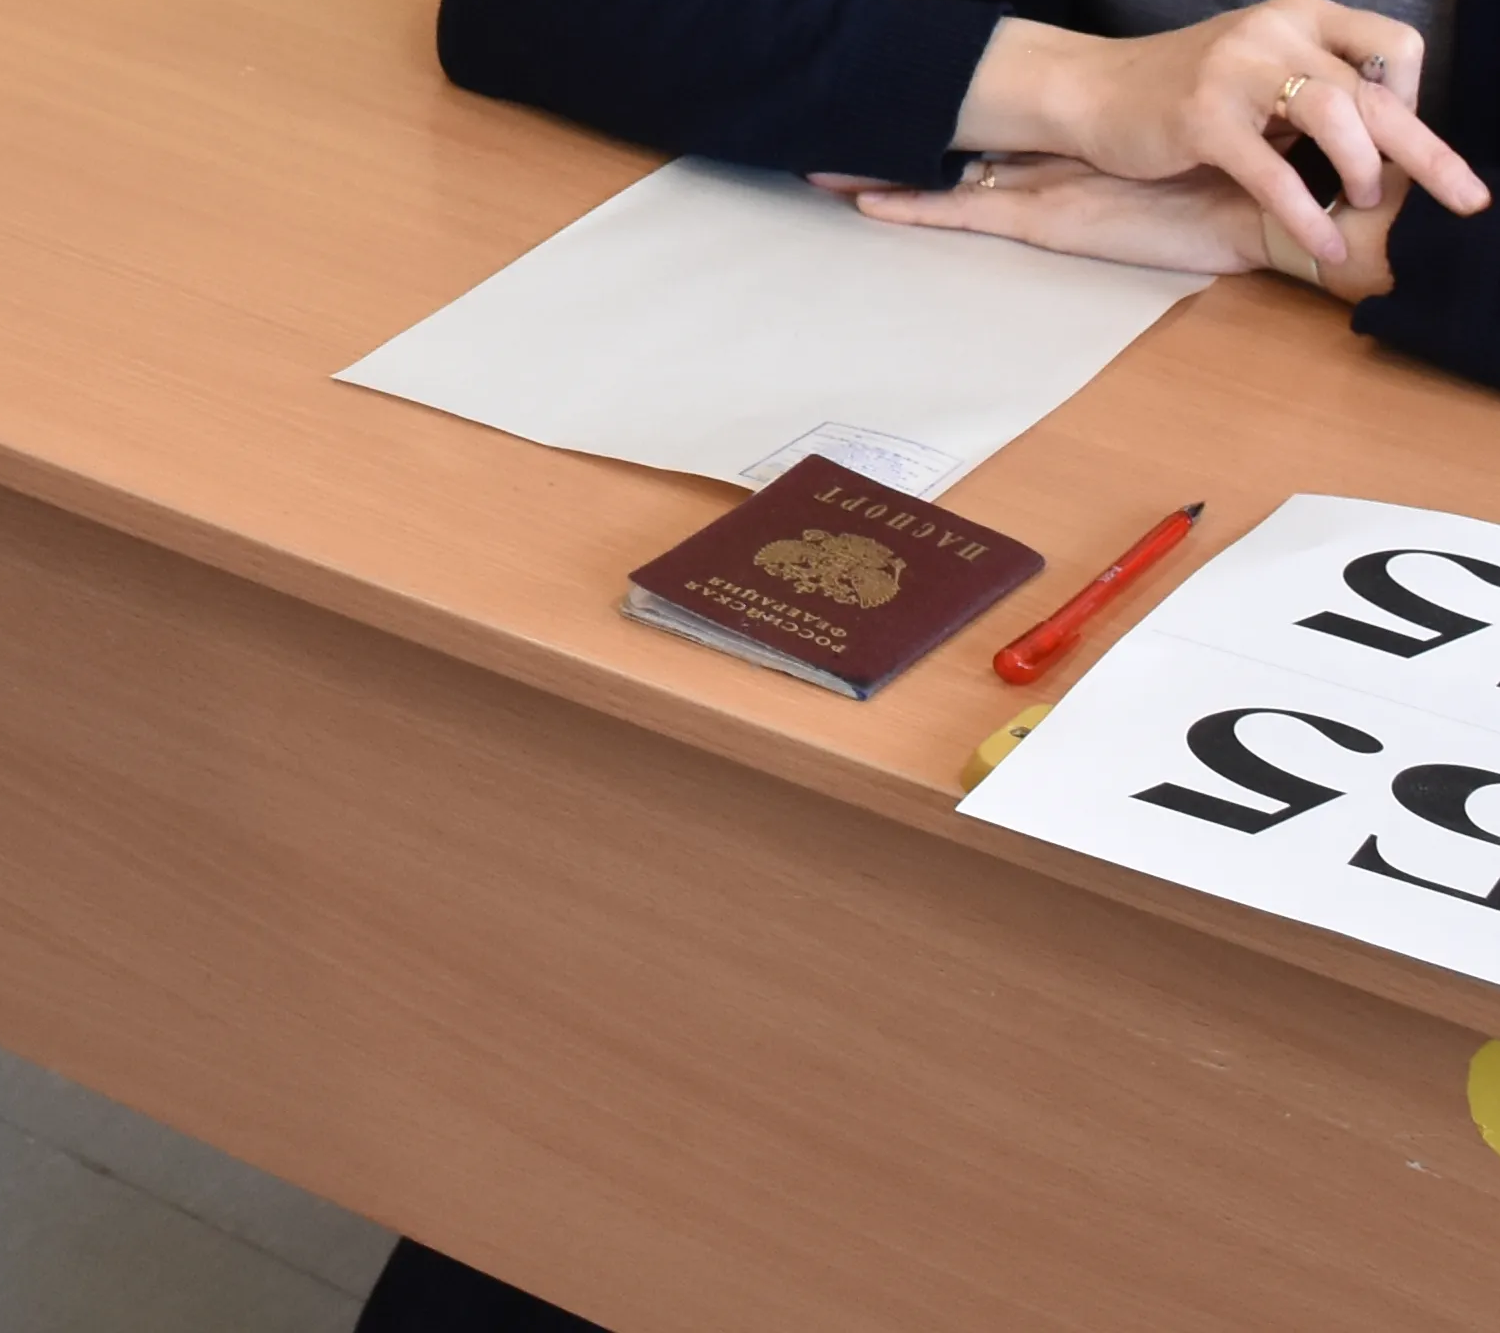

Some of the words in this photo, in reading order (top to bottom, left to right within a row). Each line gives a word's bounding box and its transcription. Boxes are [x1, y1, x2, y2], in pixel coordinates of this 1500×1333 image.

[813, 485, 990, 563] ПАСПОРТ
[684, 579, 847, 654] РОССИЙСКАЯ
[708, 575, 848, 638] ФЕДЕРАЦИЯ
